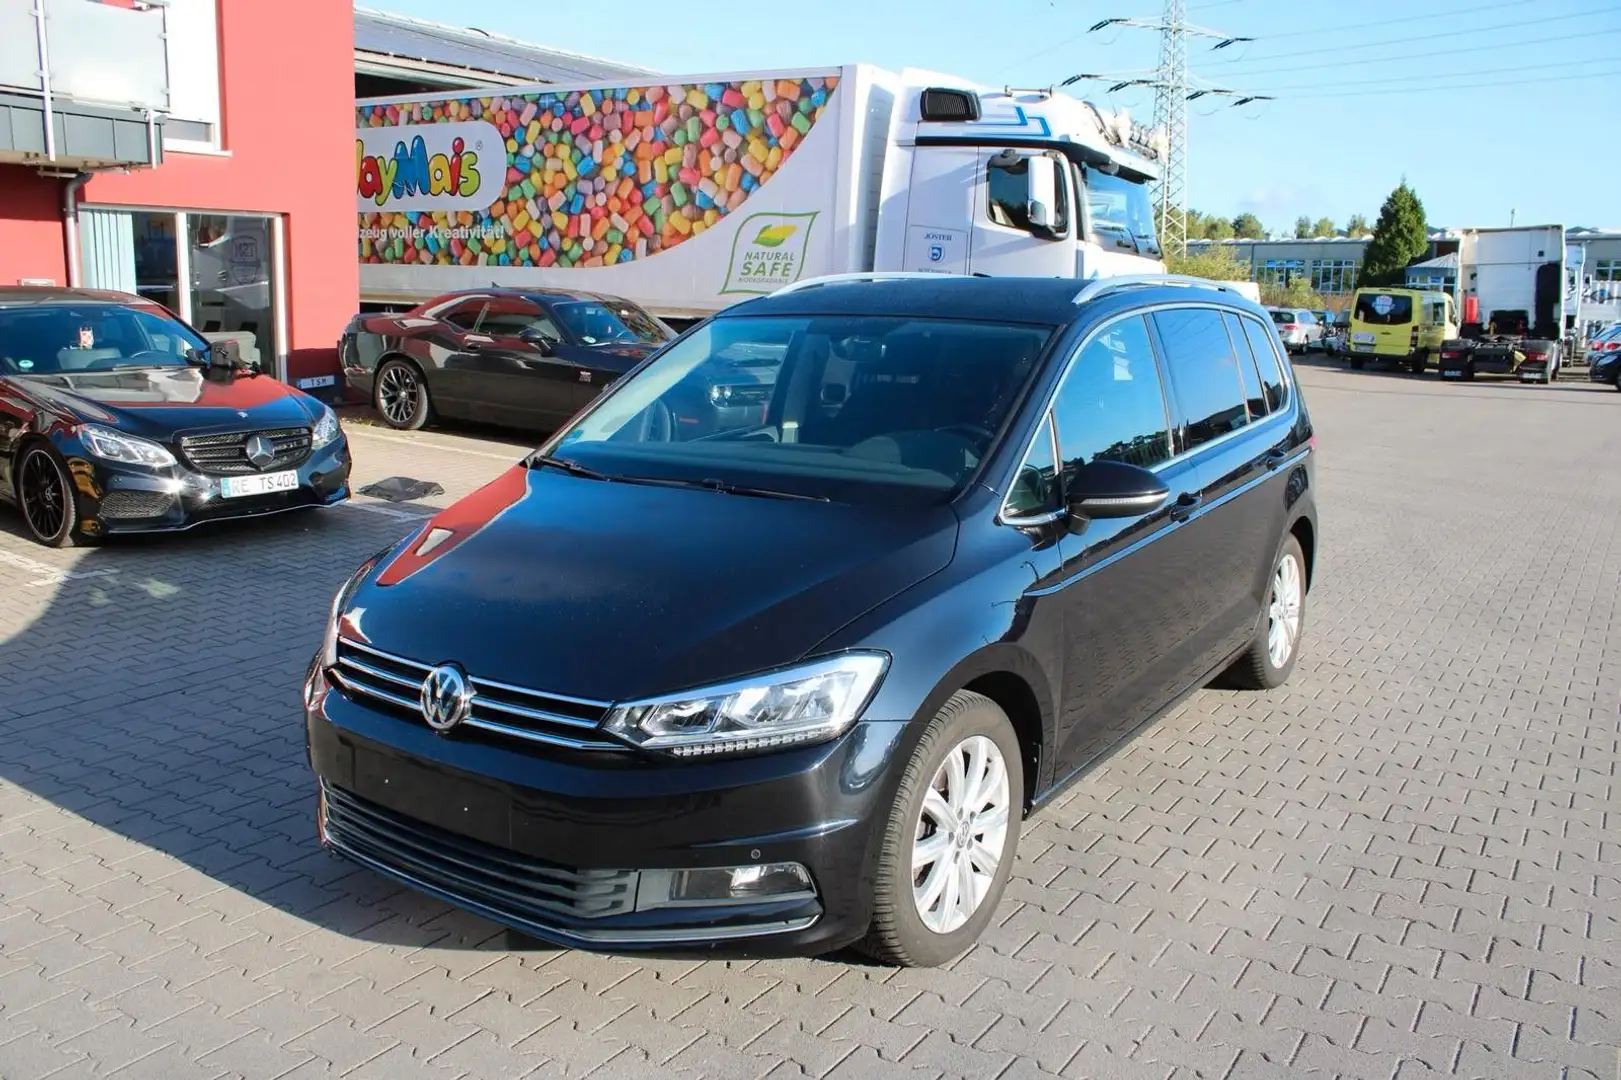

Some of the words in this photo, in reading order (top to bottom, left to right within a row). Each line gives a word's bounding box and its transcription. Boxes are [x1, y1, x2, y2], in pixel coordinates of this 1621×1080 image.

[390, 225, 425, 239] voller
[744, 251, 795, 261] NATURAL
[741, 261, 793, 277] SAFE
[231, 480, 250, 494] RE
